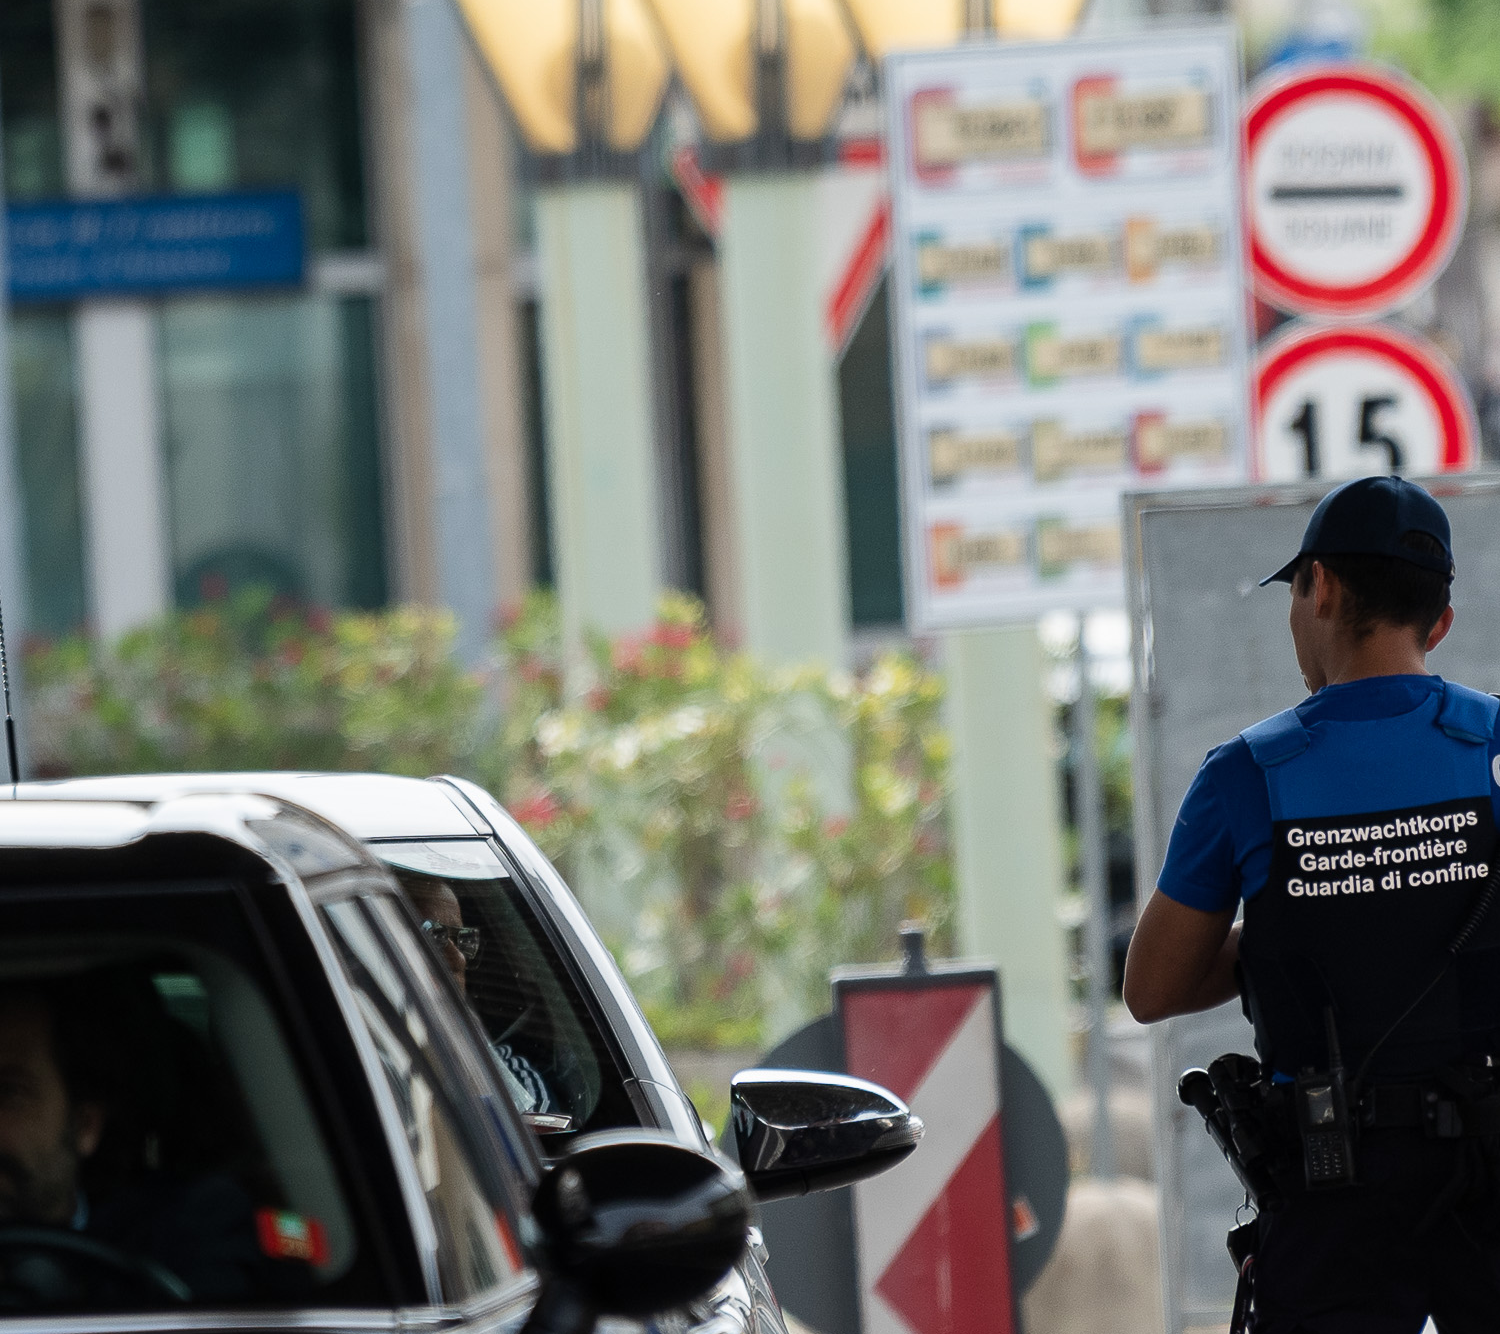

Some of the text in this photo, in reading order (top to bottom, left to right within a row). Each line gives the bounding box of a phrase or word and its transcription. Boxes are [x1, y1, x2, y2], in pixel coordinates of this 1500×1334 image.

[1287, 396, 1407, 476] 15
[1287, 809, 1478, 847] Grenzwachtkorps
[1299, 838, 1468, 872] Garde-frontière
[1287, 861, 1489, 897] Guardia di confine
